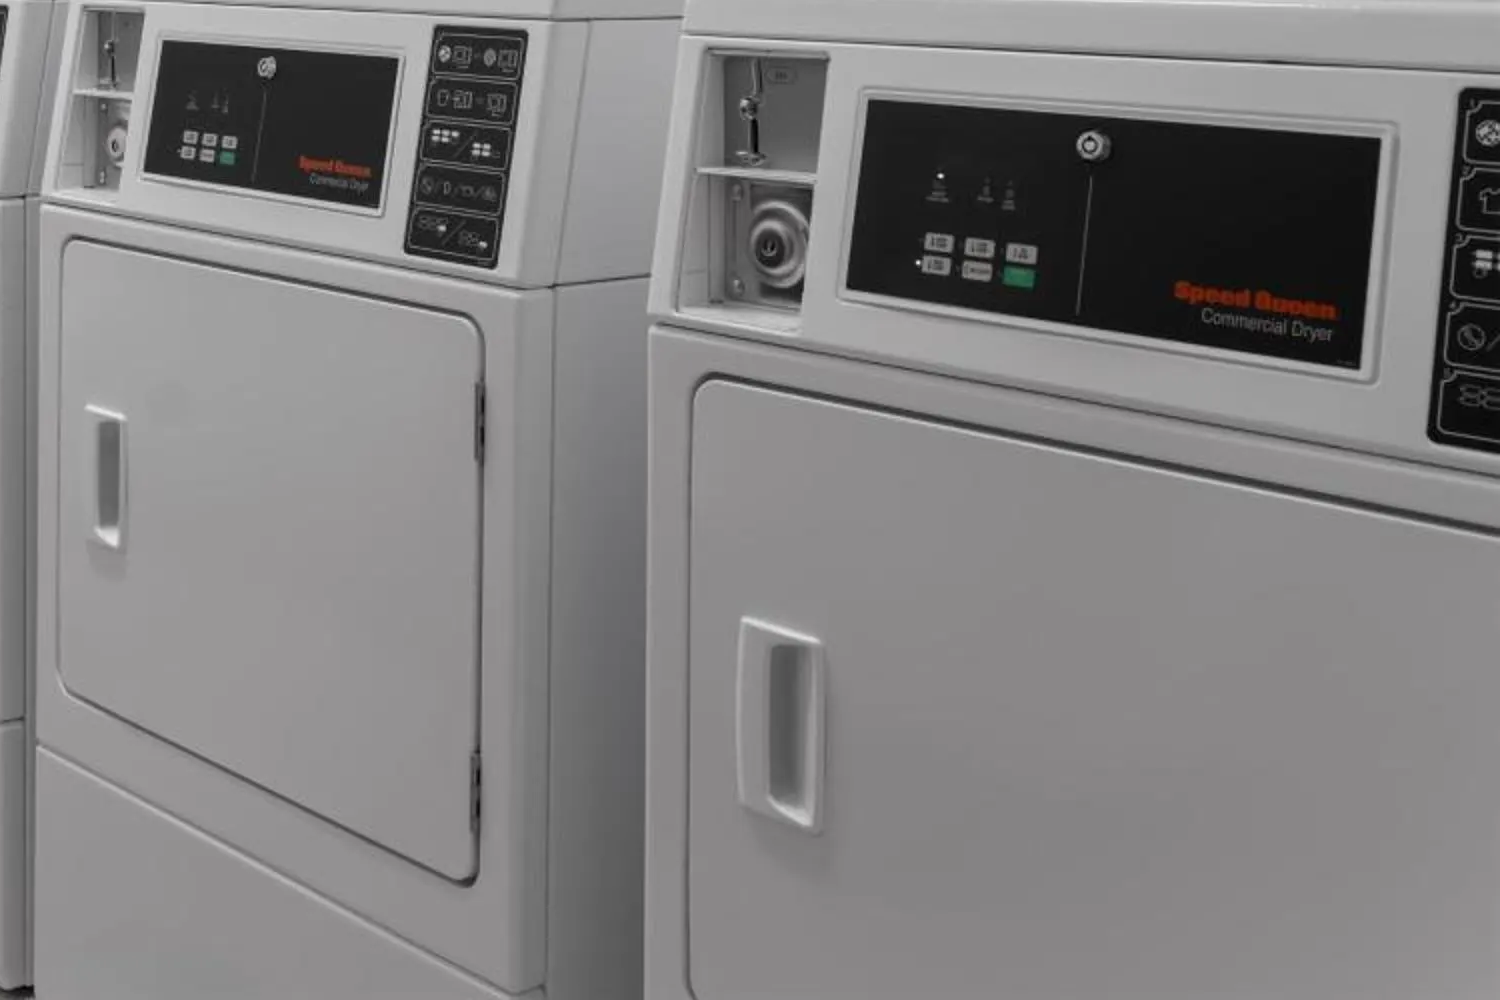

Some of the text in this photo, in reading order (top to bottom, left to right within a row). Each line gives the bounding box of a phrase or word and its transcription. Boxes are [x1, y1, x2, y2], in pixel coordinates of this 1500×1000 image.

[1174, 280, 1338, 320] Speed Queen
[1201, 307, 1334, 344] Commercial Dryer
